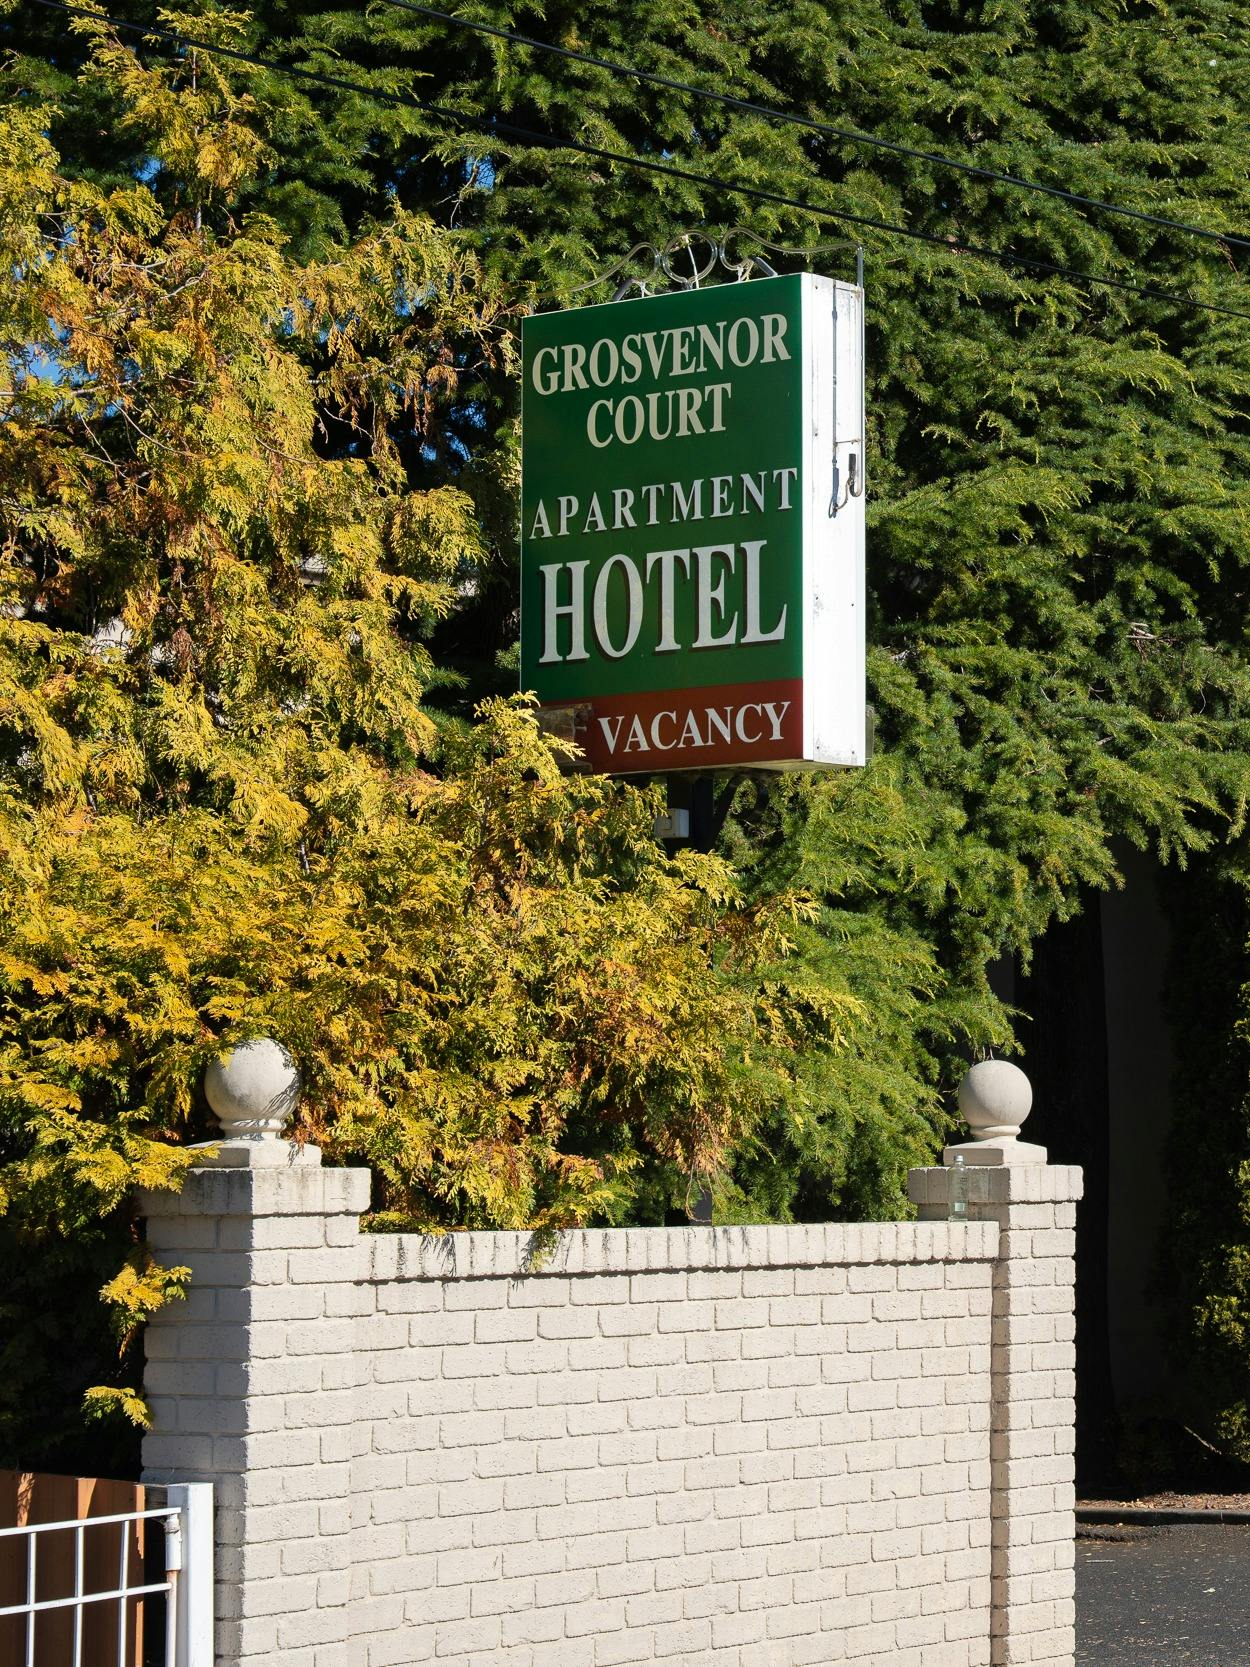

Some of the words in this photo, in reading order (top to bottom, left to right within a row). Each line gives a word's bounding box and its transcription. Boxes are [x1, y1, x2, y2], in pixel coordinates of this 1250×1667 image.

[533, 314, 791, 395] GROSVENOR
[587, 383, 731, 447] COURT
[530, 468, 797, 539] APARTMENT
[539, 540, 787, 662] HOTEL
[598, 702, 790, 753] VACANCY
